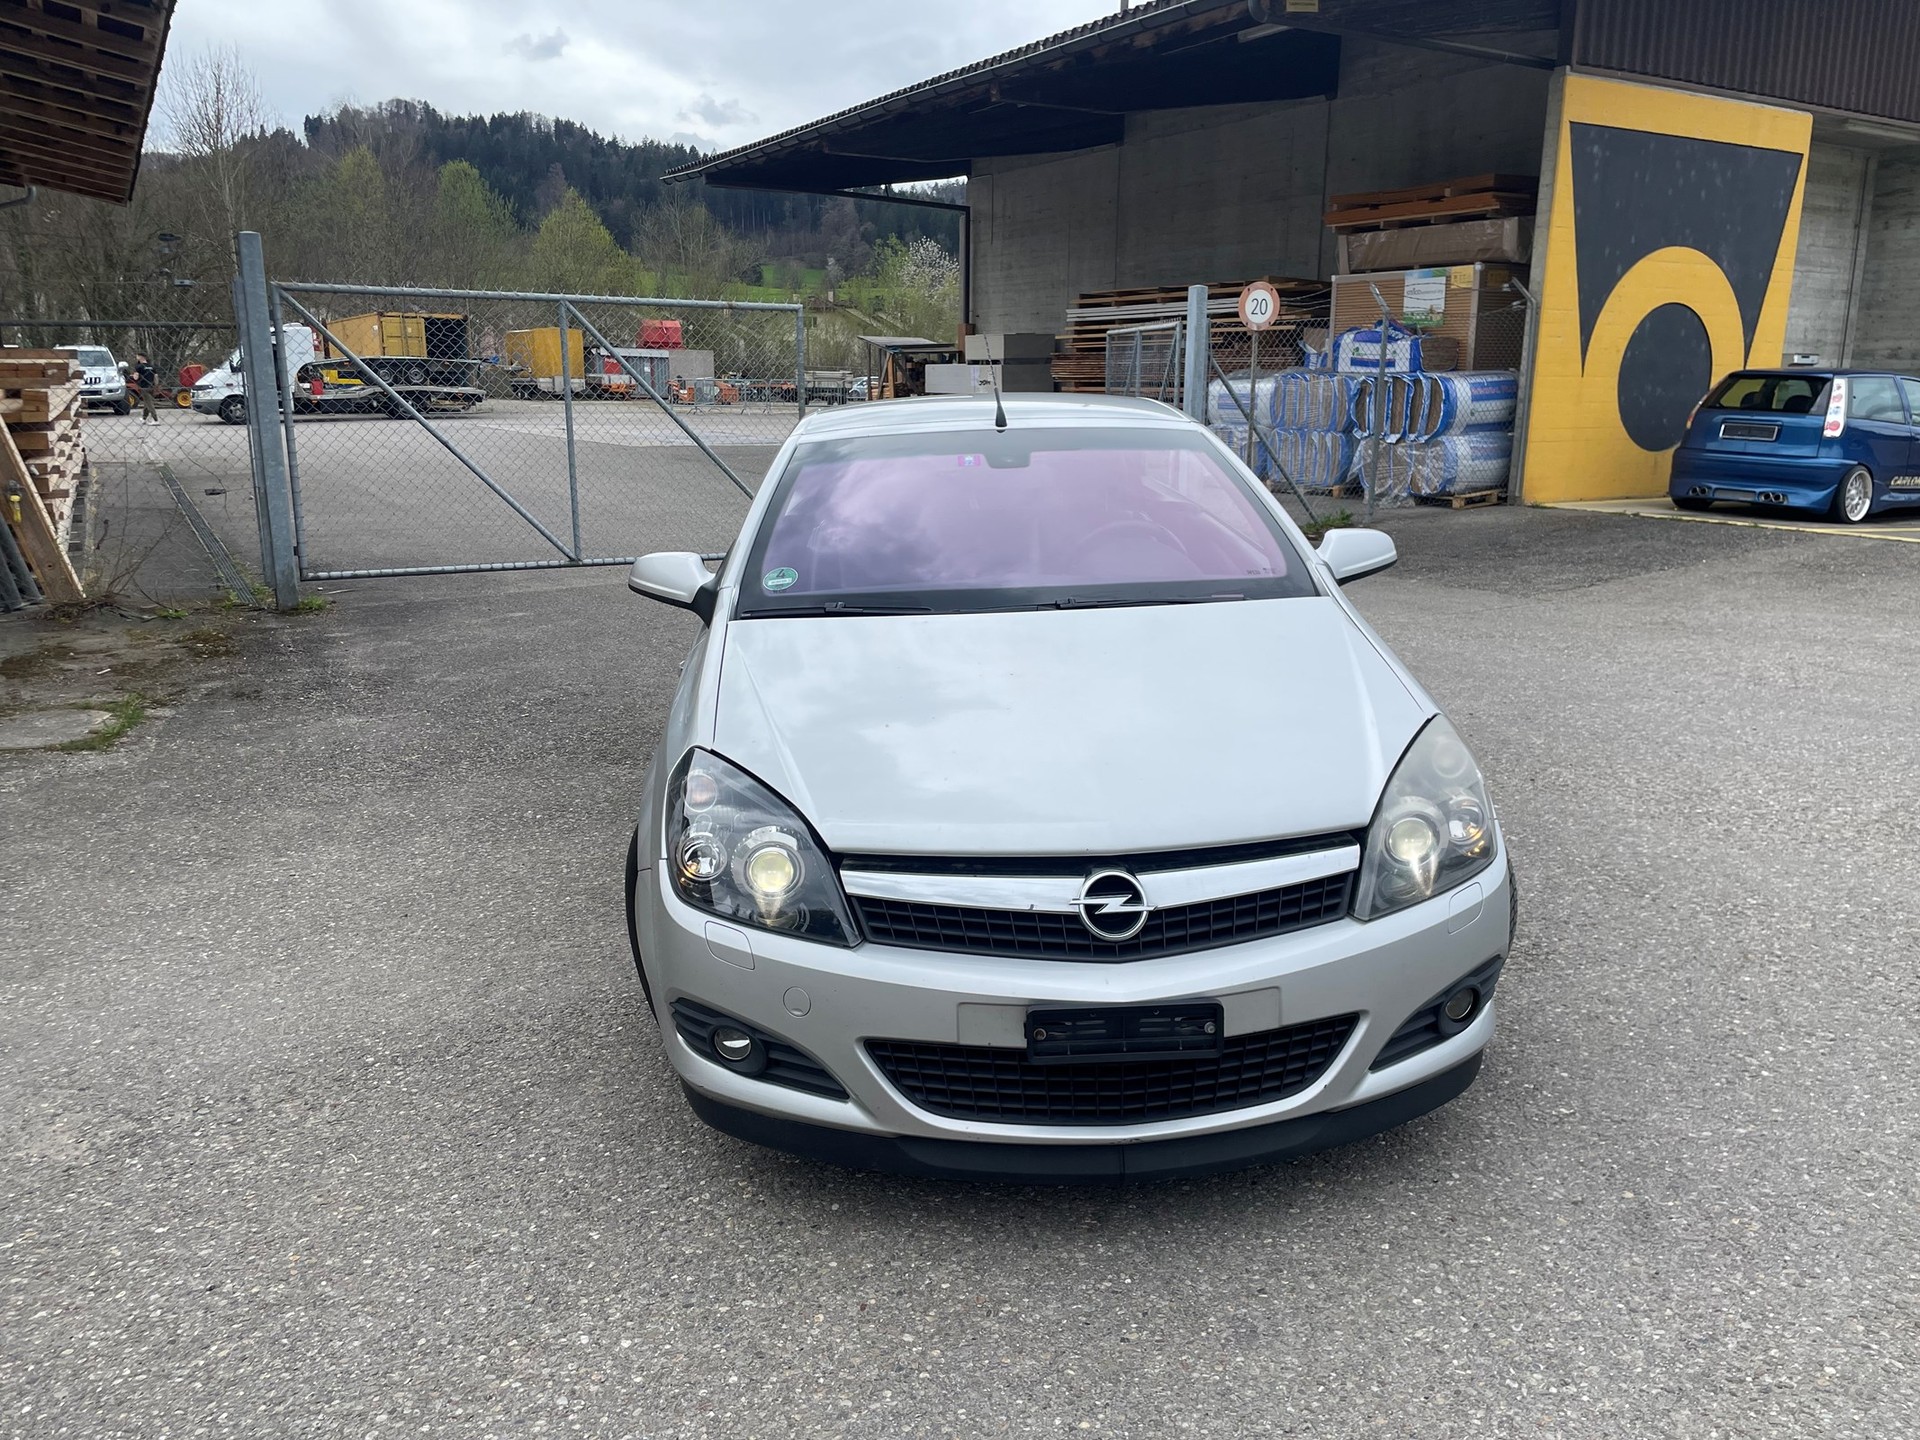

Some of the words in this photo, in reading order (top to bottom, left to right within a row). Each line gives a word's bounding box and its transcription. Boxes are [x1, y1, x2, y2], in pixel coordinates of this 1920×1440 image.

[1251, 298, 1268, 316] 20
[1890, 475, 1920, 486] CARLO
[776, 569, 786, 579] 4
